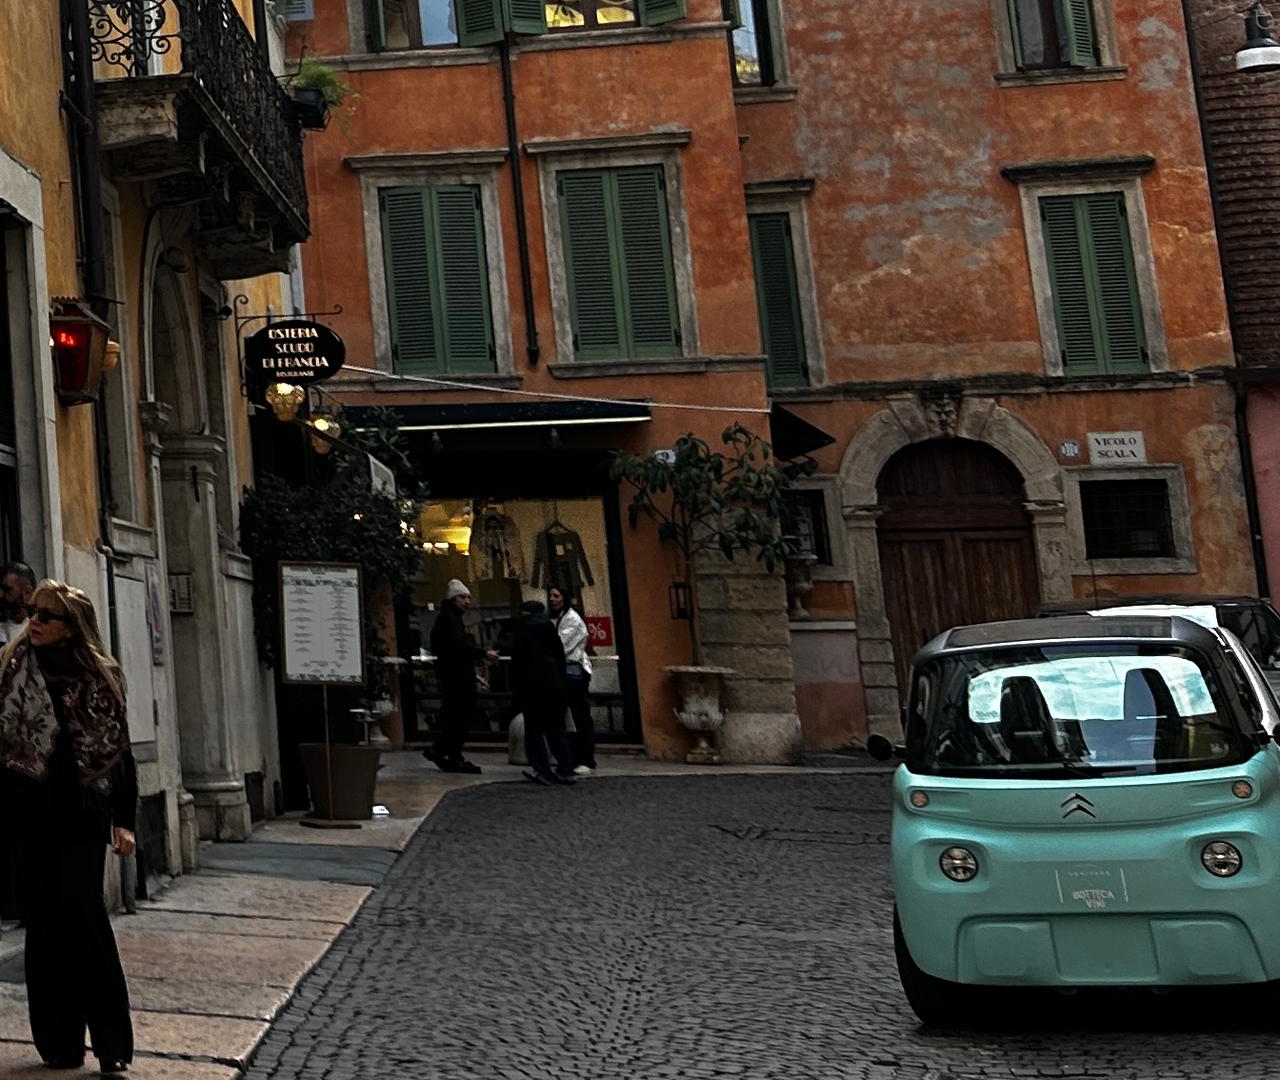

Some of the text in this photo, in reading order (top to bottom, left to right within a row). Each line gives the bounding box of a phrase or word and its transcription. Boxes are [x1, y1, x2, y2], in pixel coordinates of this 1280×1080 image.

[268, 327, 319, 339] OSTERIA
[275, 342, 315, 354] SCUDO
[262, 356, 330, 369] DI FRANCIA
[1094, 437, 1137, 447] VICOLO
[1098, 449, 1138, 459] SCALA
